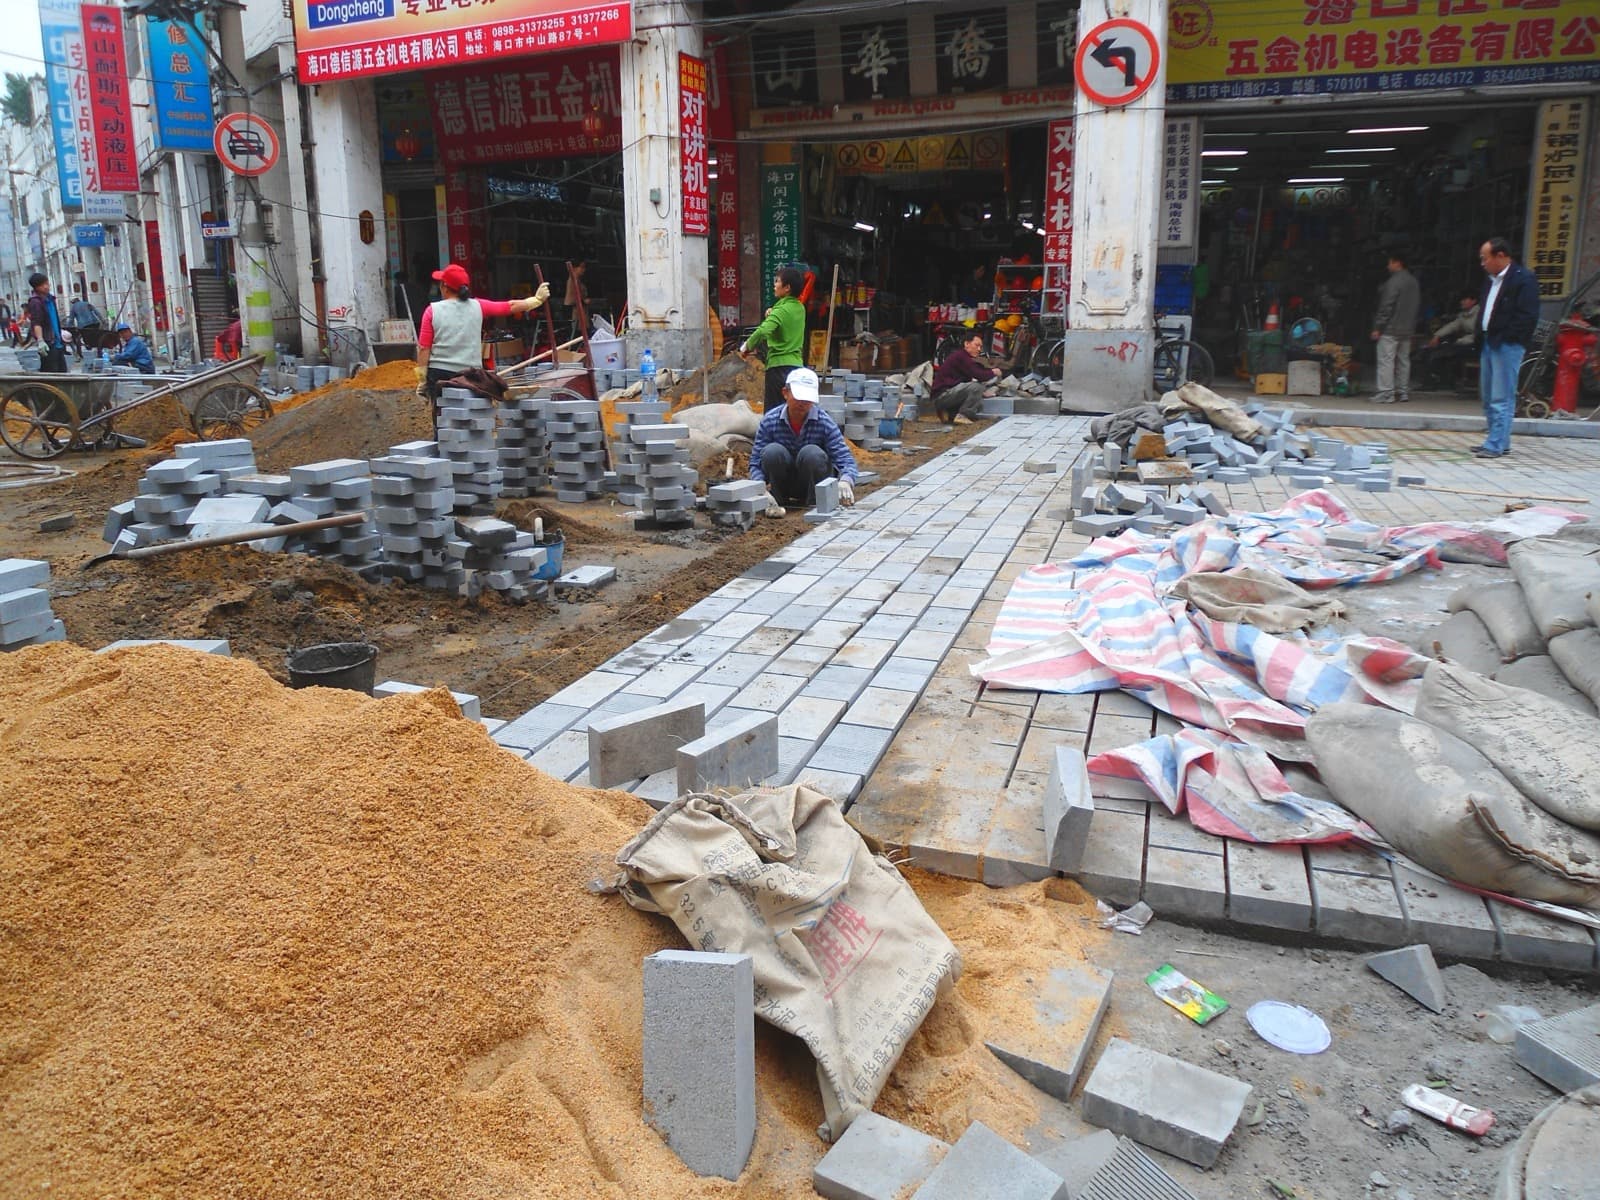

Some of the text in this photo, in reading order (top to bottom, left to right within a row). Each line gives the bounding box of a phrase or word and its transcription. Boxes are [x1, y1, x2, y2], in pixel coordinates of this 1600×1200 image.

[317, 0, 385, 23] Dongcheng
[491, 18, 566, 38] 0898-31373255
[570, 9, 620, 26] 31377266
[493, 27, 599, 53] 海口市中山路87号-1
[306, 35, 459, 77] 海口德信源五金机电有限公司
[1326, 77, 1368, 90] 570101
[1414, 70, 1474, 86] 66246172
[681, 91, 708, 194] 对讲机
[1046, 234, 1073, 247] 厂家
